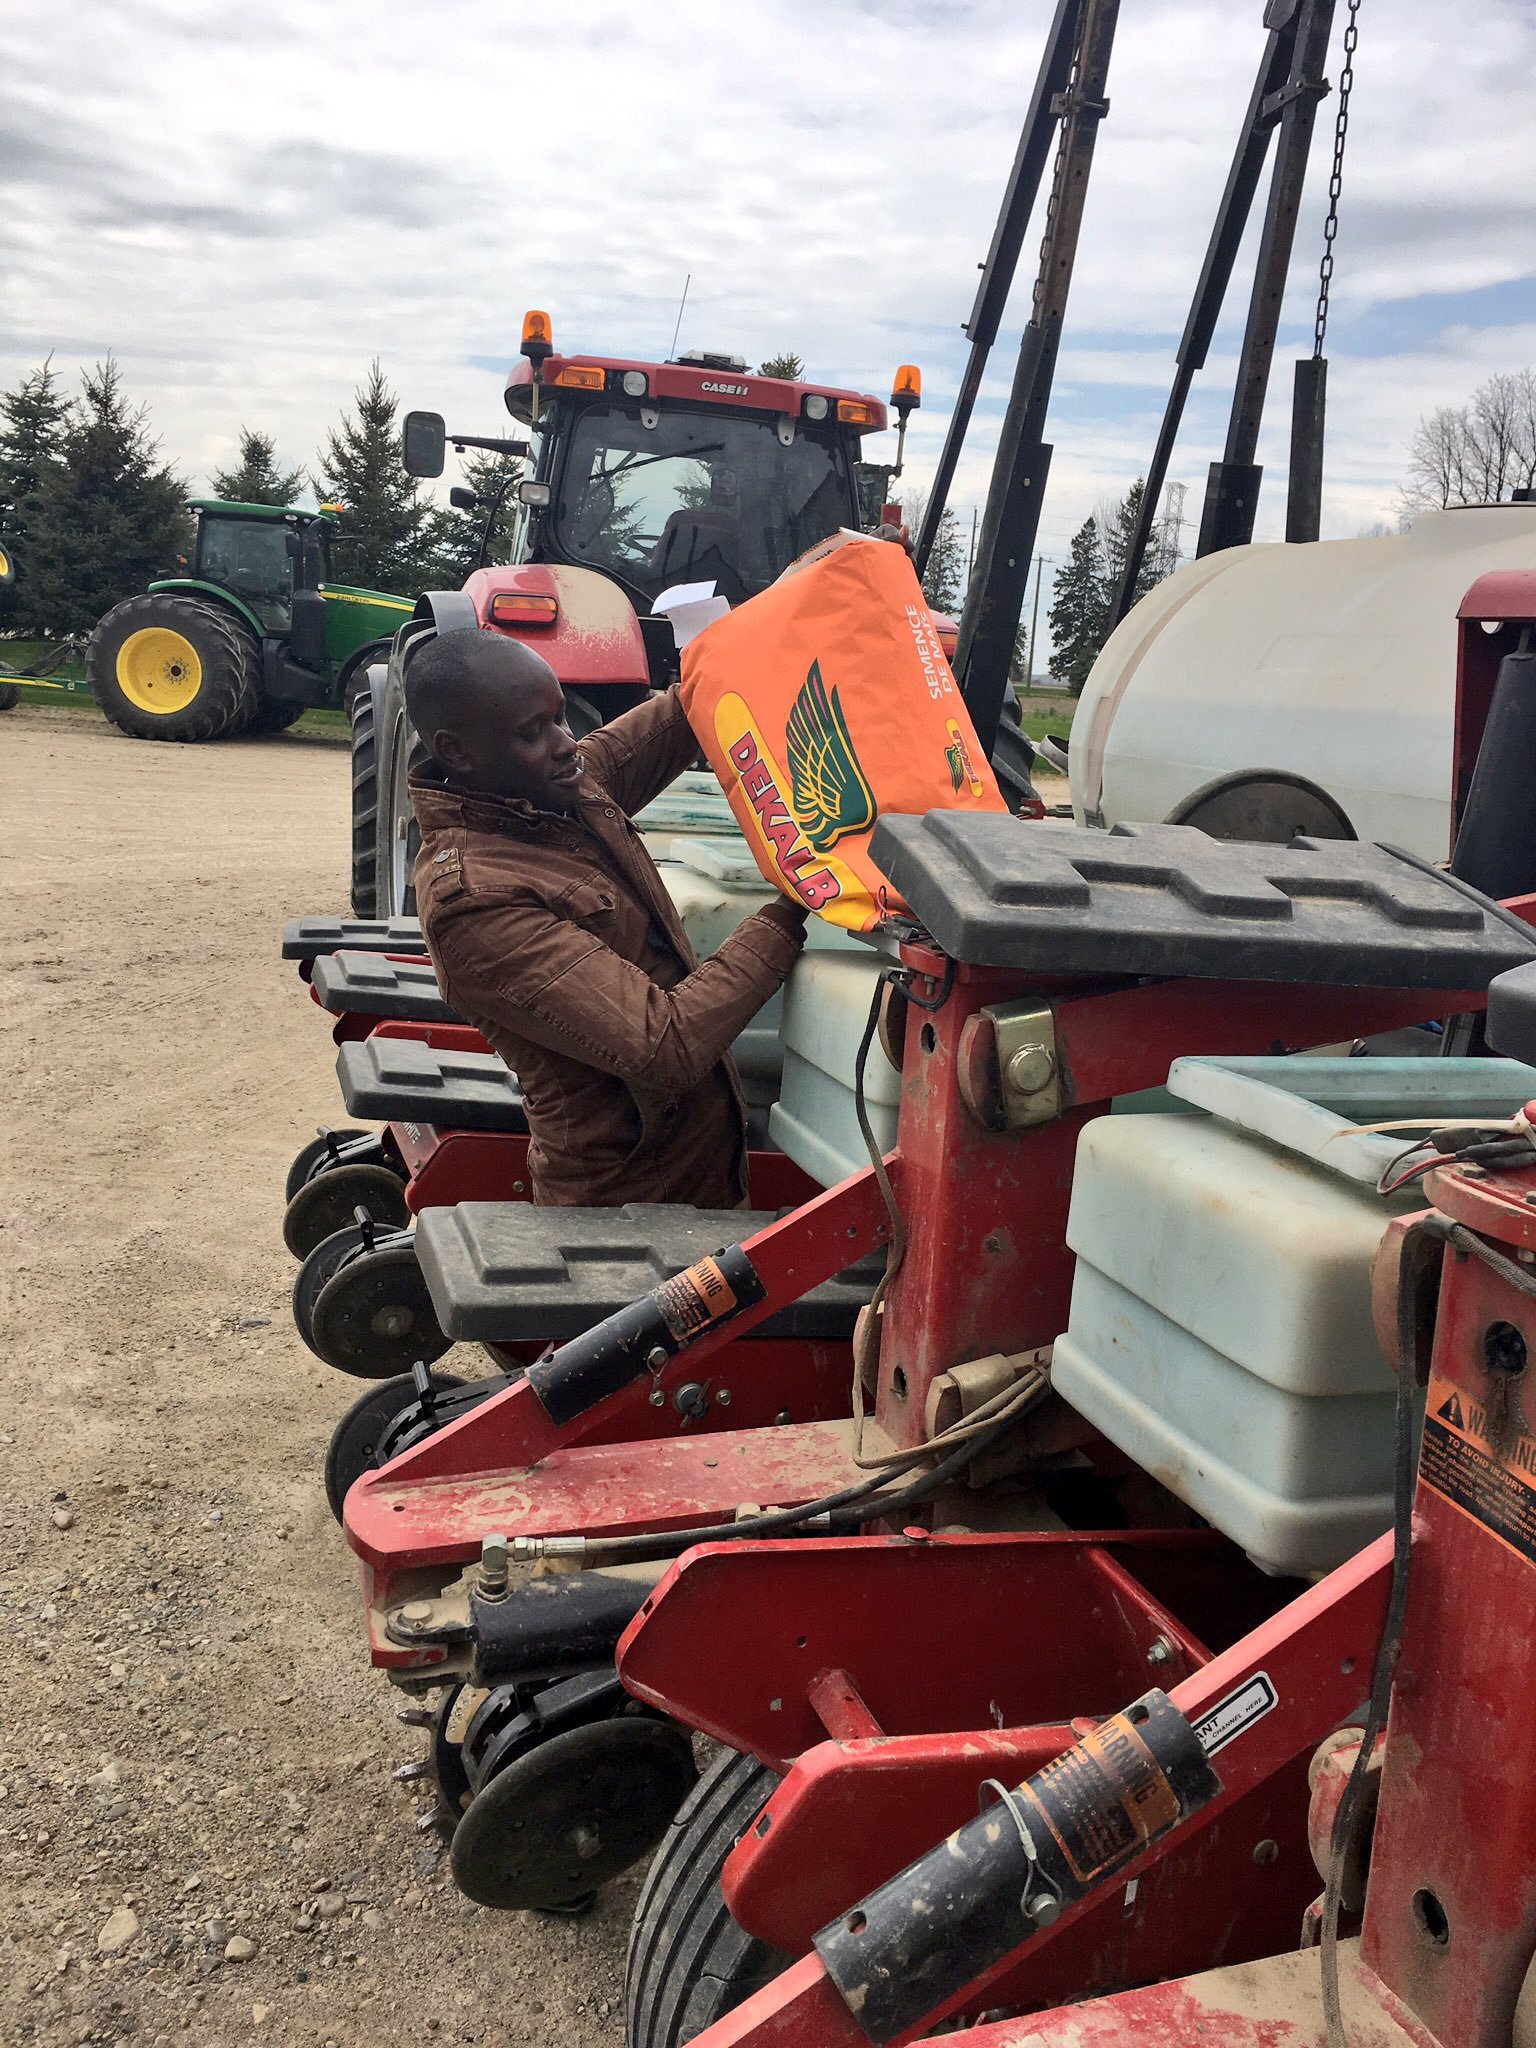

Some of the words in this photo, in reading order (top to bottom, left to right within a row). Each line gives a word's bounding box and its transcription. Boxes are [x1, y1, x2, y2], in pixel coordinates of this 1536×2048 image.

[701, 381, 736, 394] CASE
[905, 604, 943, 700] SEMENCE
[938, 665, 953, 693] DE
[952, 729, 979, 784] DEKALB
[729, 730, 842, 911] DEKALB
[692, 1260, 723, 1298] RNING
[1447, 1435, 1460, 1449] TO
[1461, 1446, 1489, 1469] AVOID
[1212, 1713, 1242, 1738] CHANNEL
[1245, 1696, 1263, 1713] HERE
